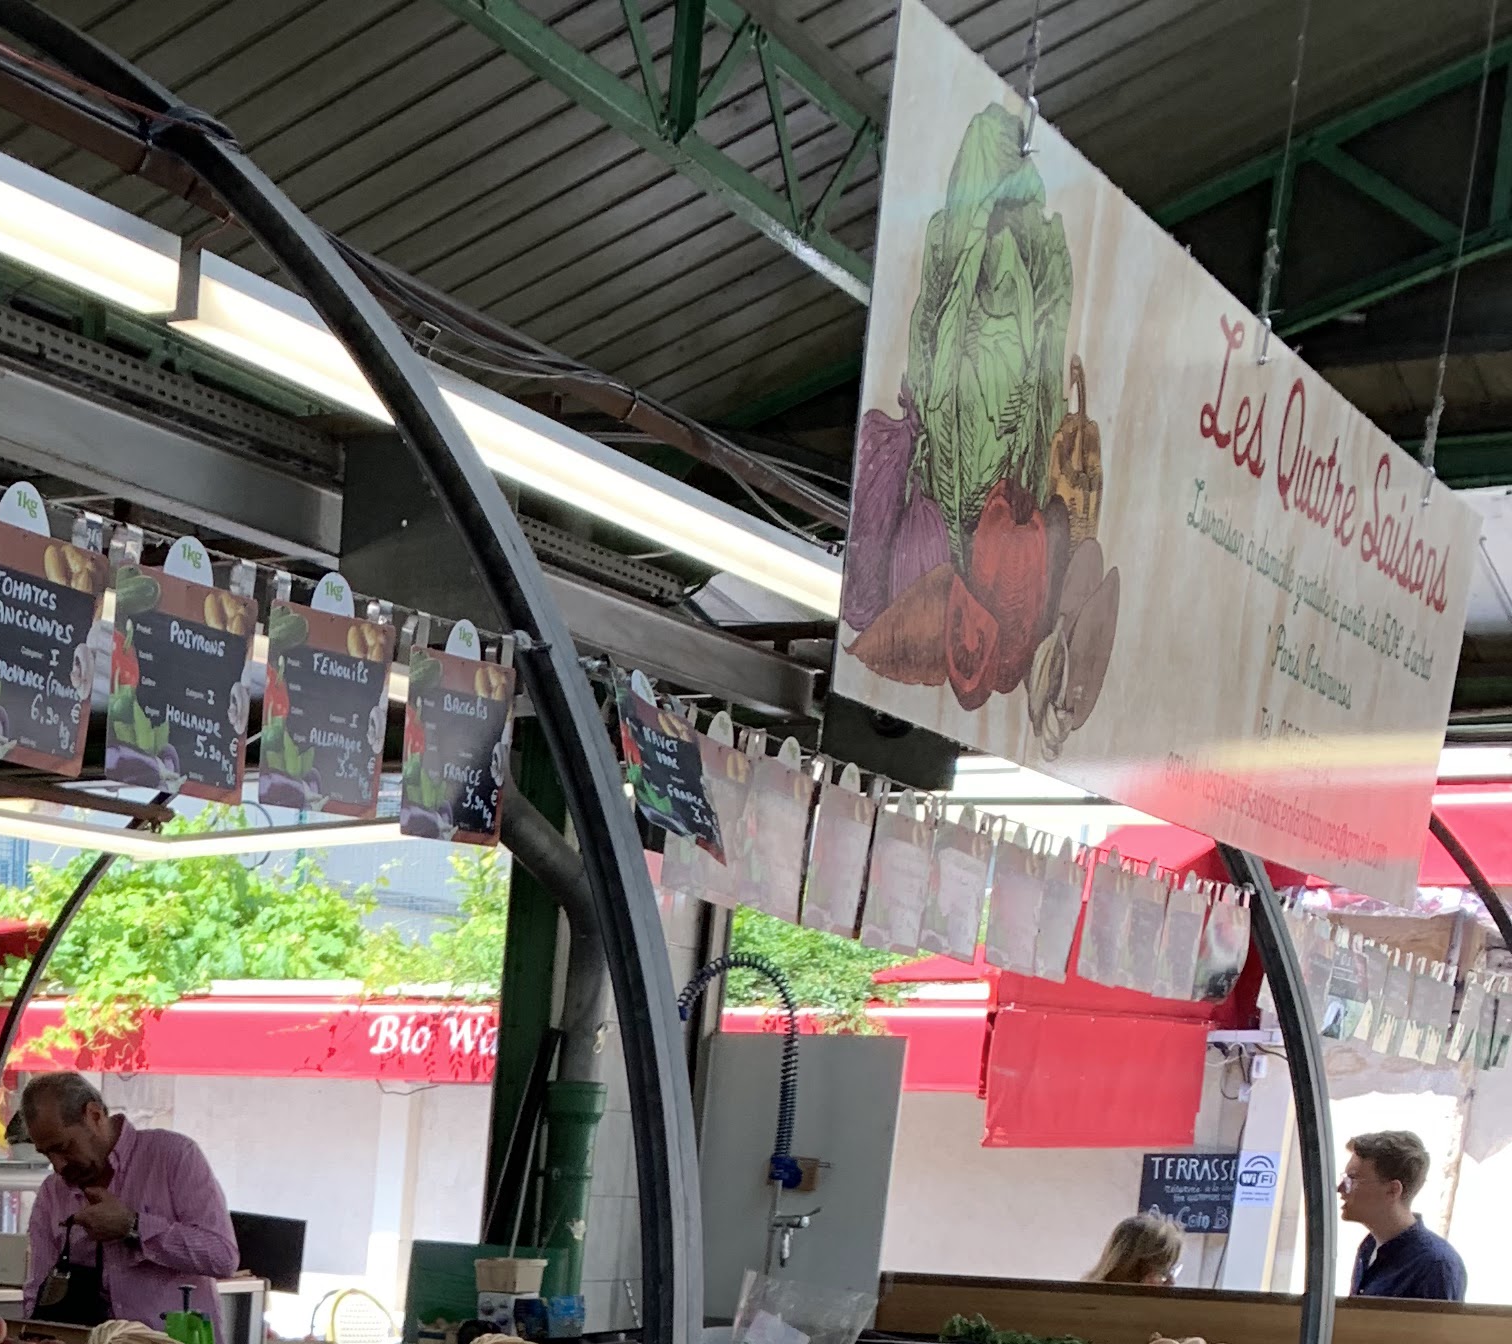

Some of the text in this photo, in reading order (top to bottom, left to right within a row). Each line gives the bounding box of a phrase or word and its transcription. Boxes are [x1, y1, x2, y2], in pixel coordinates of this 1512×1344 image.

[1199, 312, 1451, 615] Les Quatre Saisons
[15, 489, 39, 520] 1kg
[1186, 476, 1245, 561] Livraison
[180, 542, 203, 570] 1kg
[324, 580, 345, 603] 1kg
[458, 625, 474, 647] 1kg
[1271, 622, 1300, 681] Paris
[368, 1014, 500, 1057] Bio Wa
[1212, 1205, 1230, 1230] B
